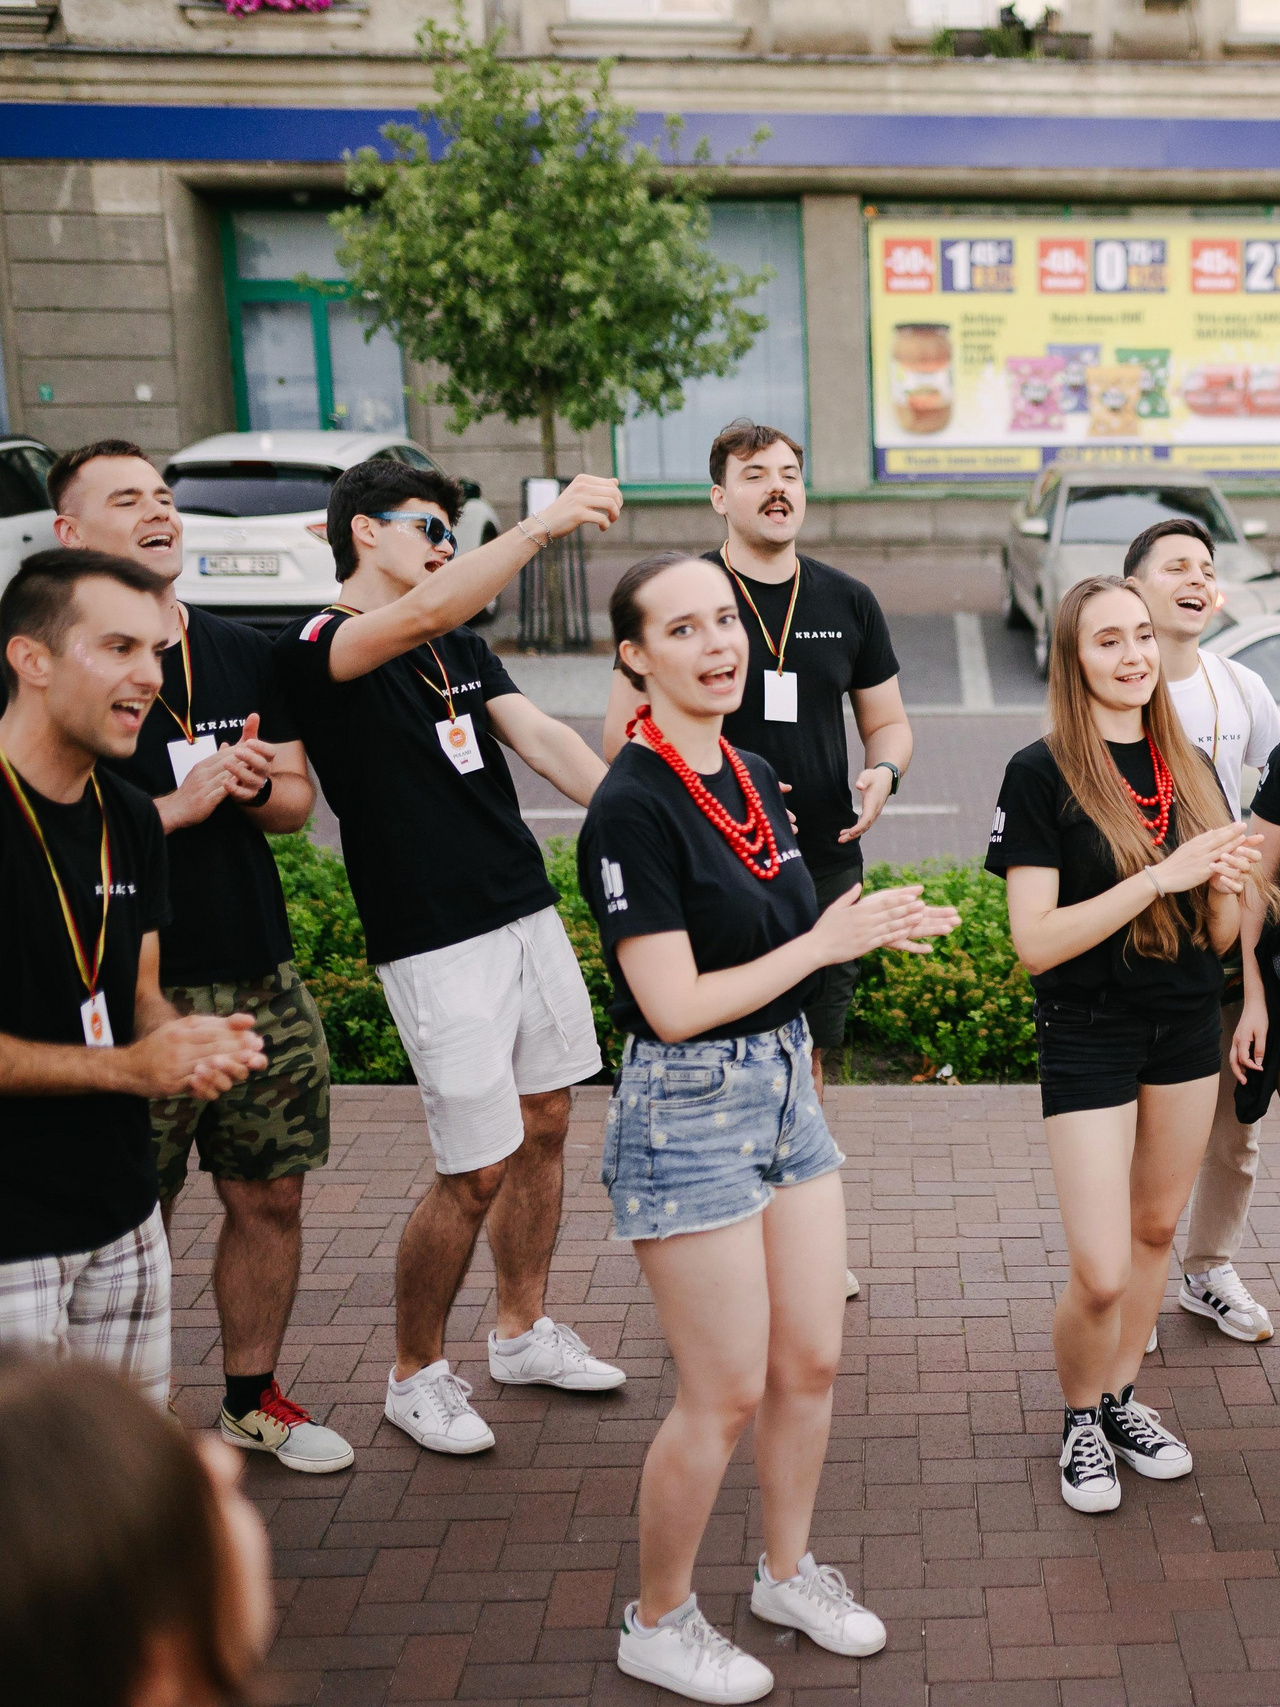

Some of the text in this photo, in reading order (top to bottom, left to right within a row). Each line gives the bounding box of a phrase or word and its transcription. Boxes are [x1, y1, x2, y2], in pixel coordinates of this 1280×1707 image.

[795, 631, 842, 639] KRAKUS
[195, 719, 246, 732] KRAKU
[453, 749, 472, 759] POLAND
